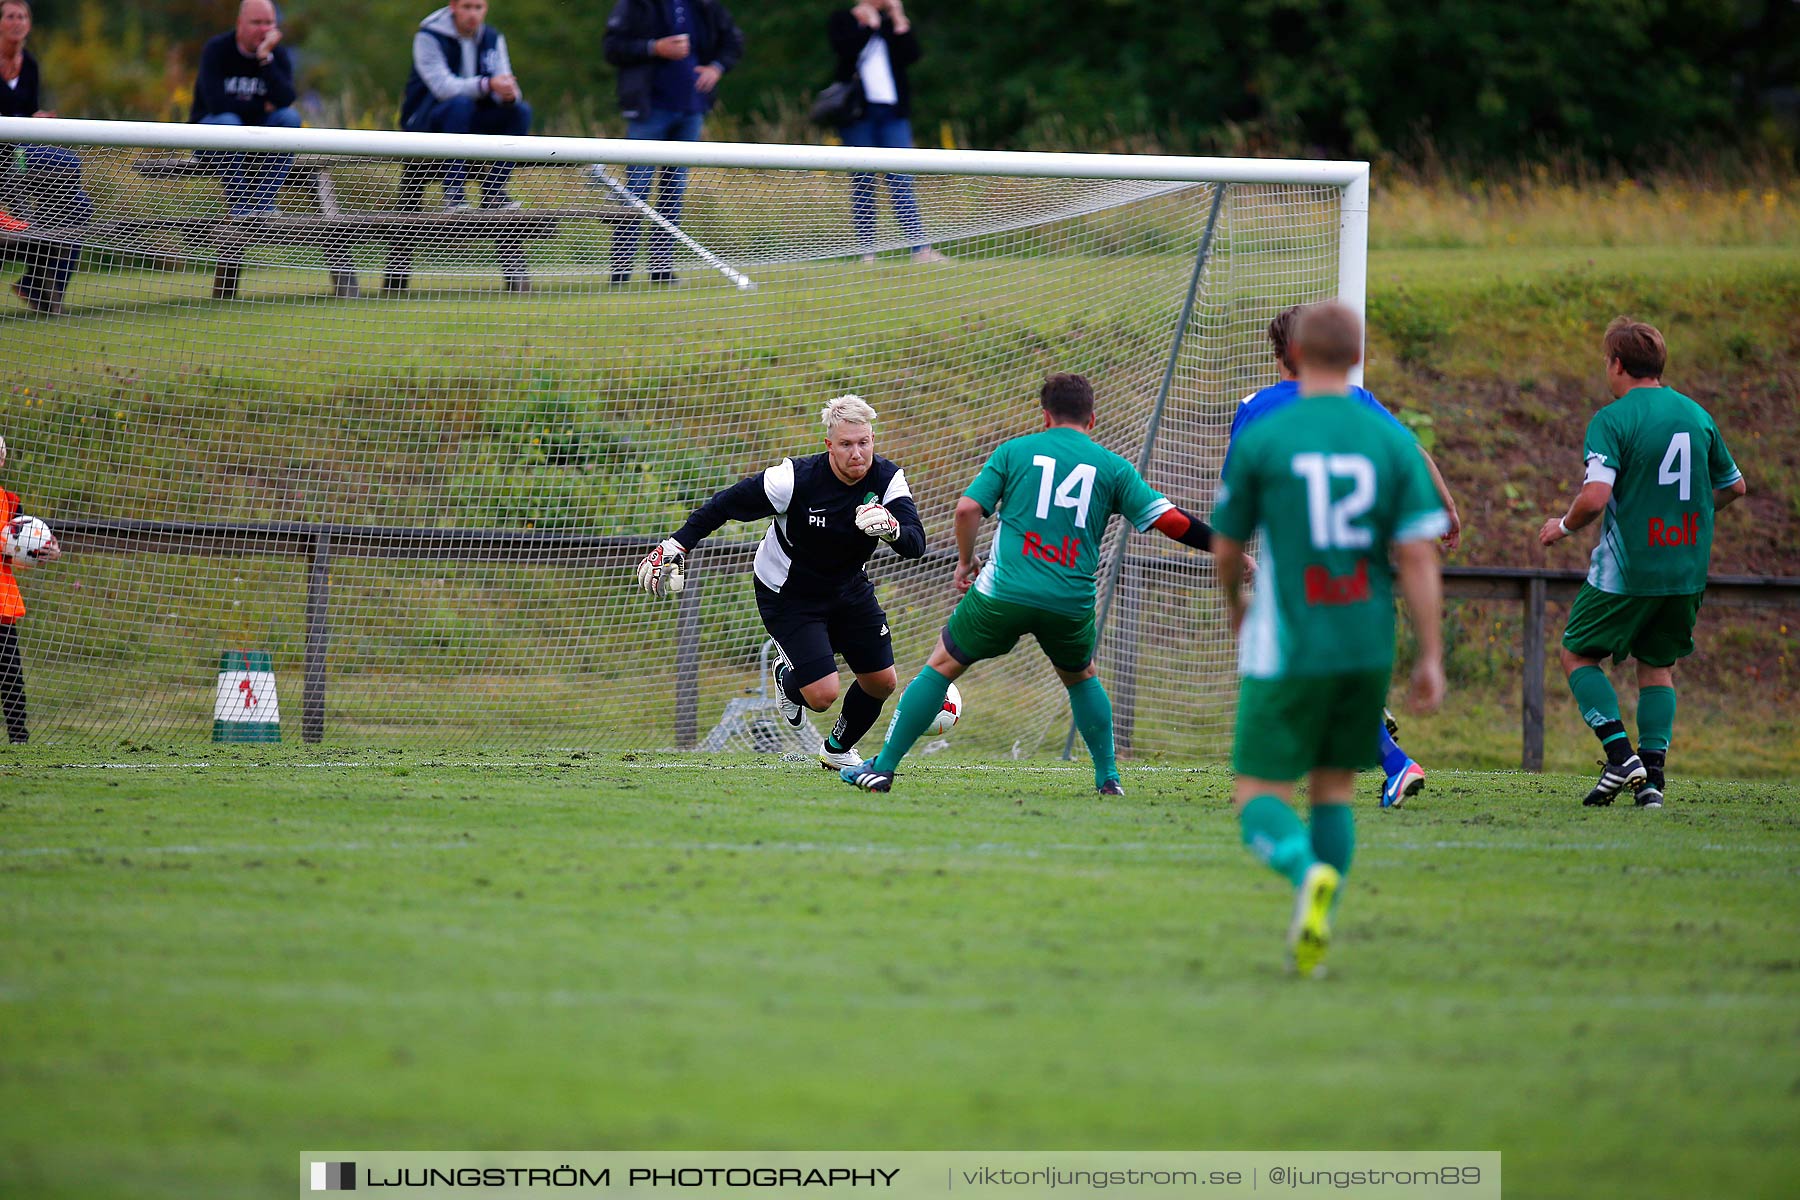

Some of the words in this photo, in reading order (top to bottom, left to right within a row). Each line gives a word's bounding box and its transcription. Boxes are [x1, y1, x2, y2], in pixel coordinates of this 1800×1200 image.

[1032, 454, 1097, 529] 14
[1658, 432, 1691, 501] 4
[808, 515, 826, 528] PH
[1292, 452, 1376, 550] 12
[1021, 531, 1081, 569] Rolf
[1648, 512, 1700, 547] Rolf
